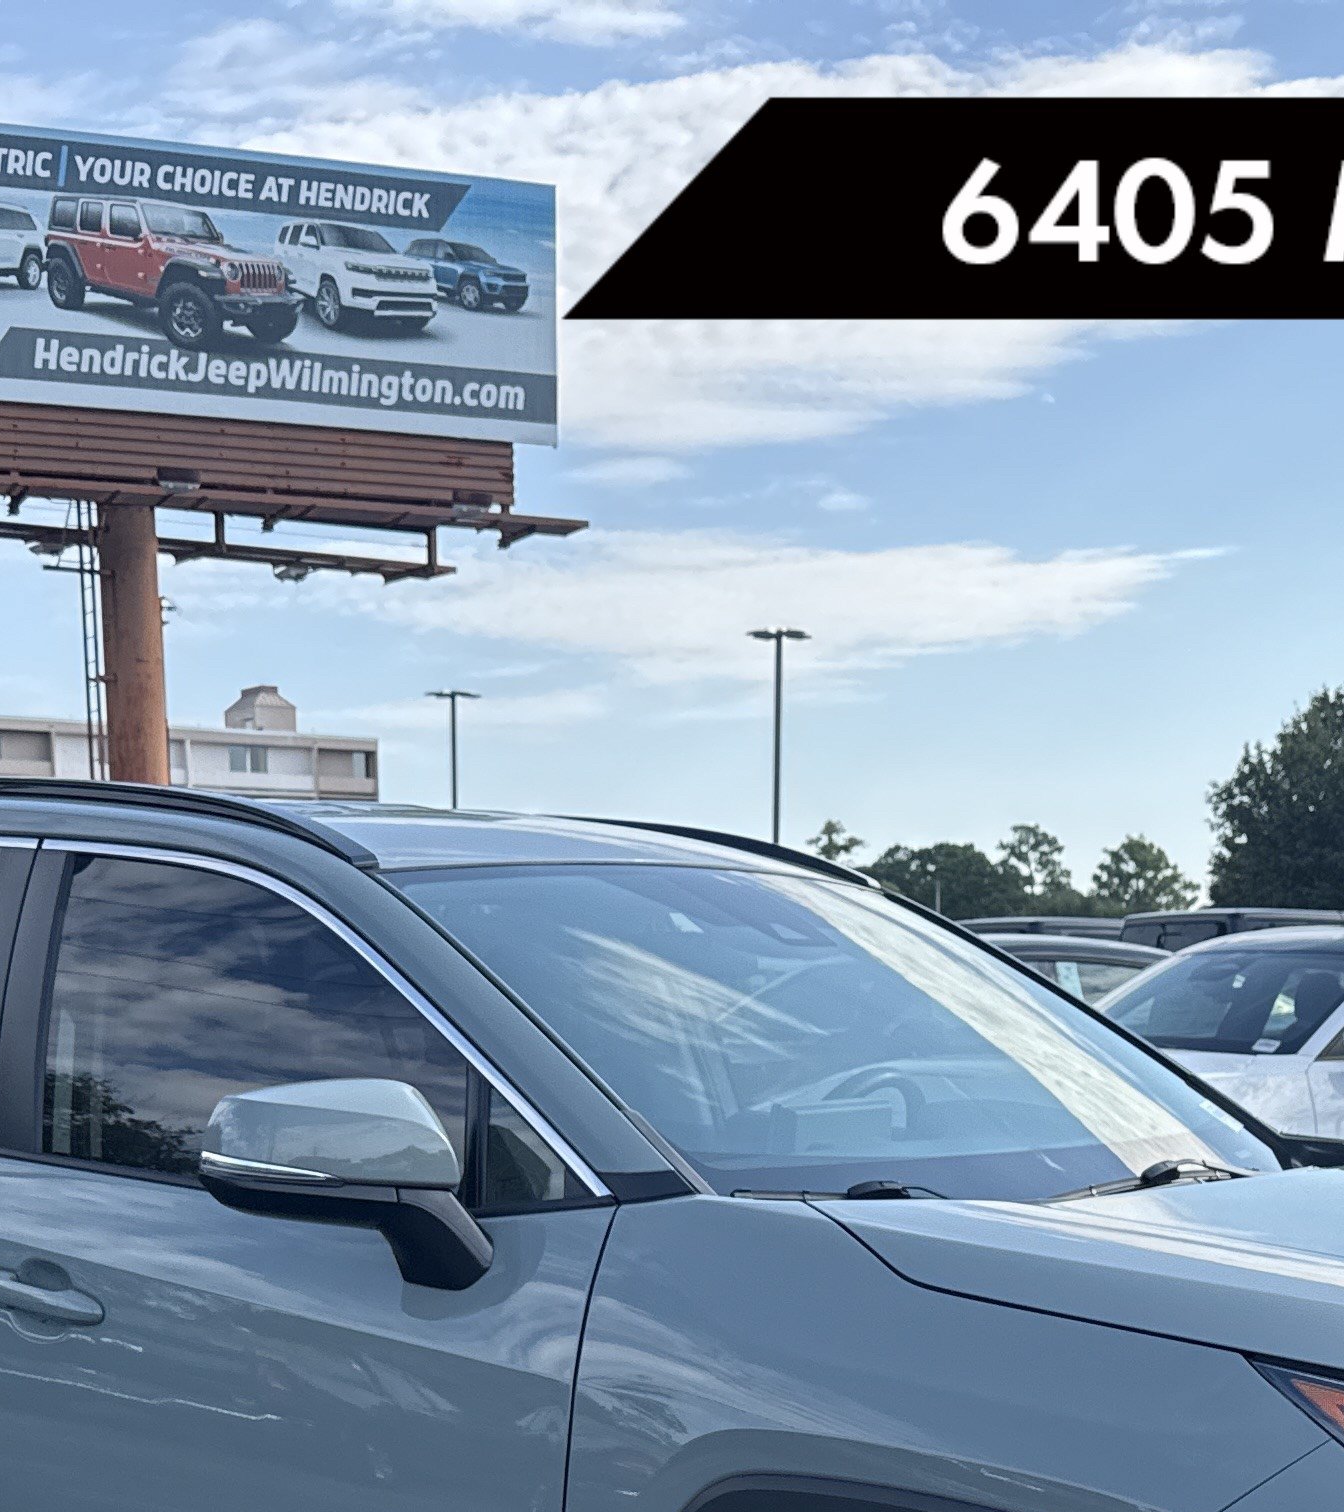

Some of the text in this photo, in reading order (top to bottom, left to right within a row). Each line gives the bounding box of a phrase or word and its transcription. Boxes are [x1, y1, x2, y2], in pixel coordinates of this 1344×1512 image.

[74, 154, 153, 189] YOUR
[156, 164, 255, 200] CHOICE
[259, 175, 296, 204] AT
[298, 180, 432, 220] HENDRICK
[33, 337, 526, 411] HendrickJeepWilmington.com
